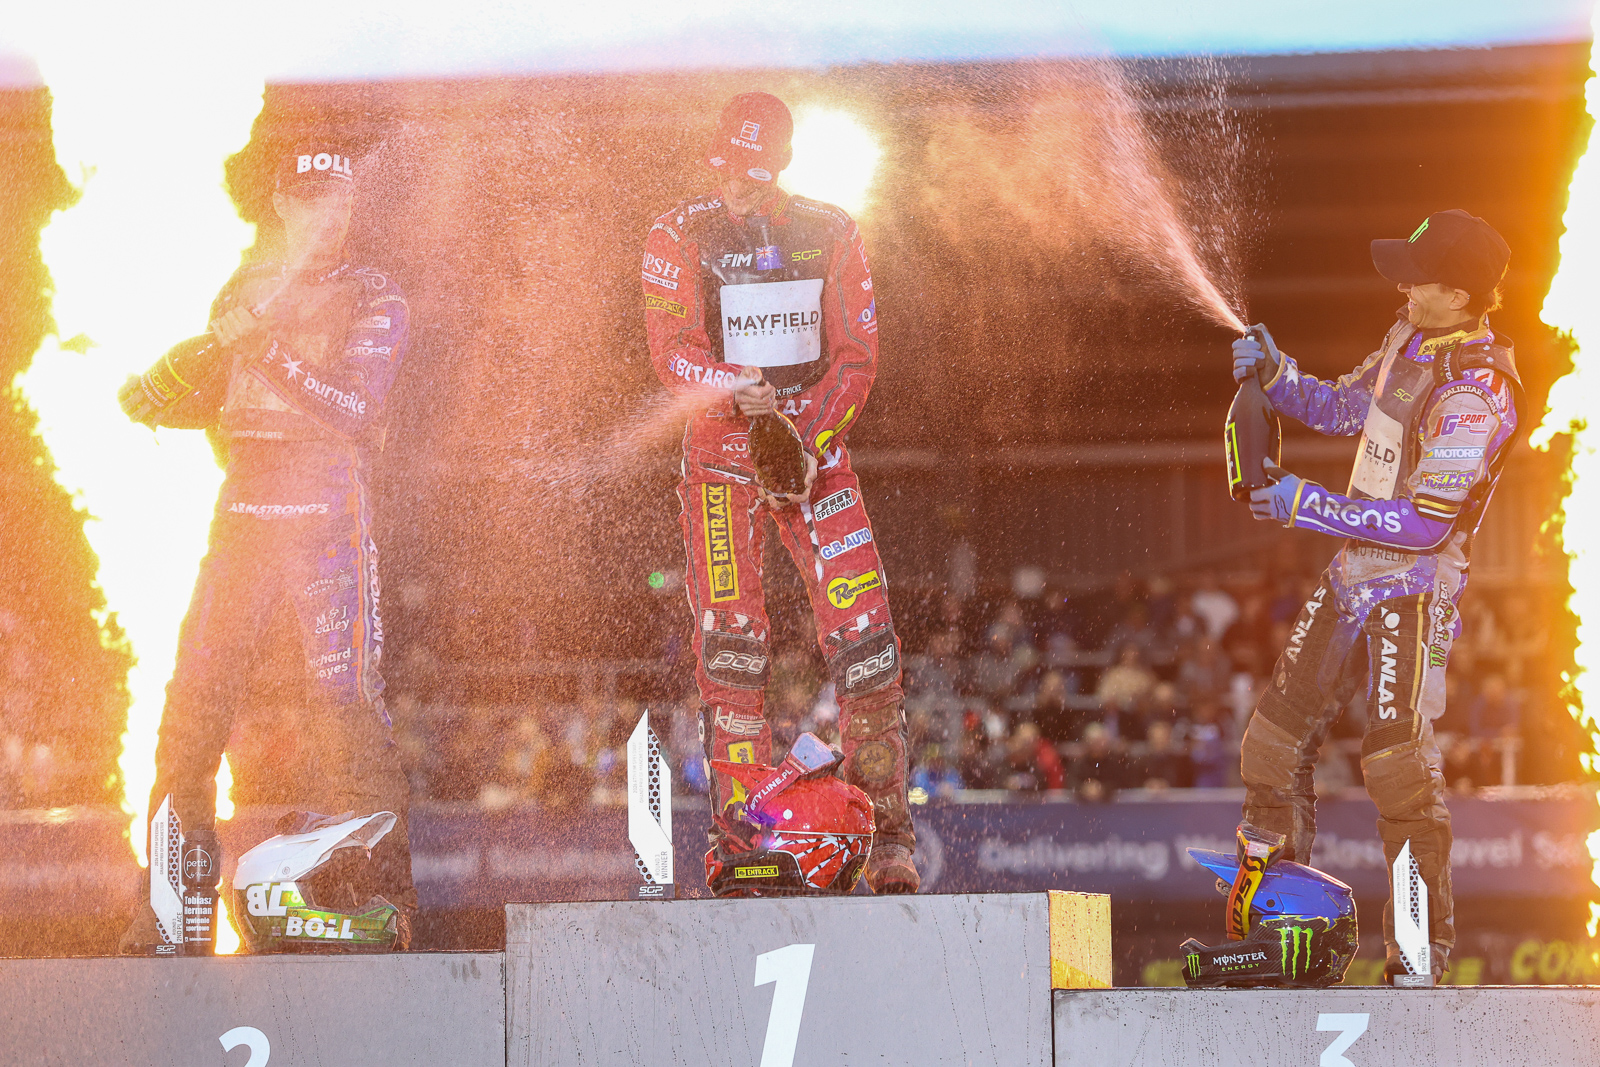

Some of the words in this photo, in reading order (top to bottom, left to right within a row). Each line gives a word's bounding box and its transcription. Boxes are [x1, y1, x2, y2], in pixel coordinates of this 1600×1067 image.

[731, 137, 762, 151] BETARD
[297, 153, 352, 175] BOLL
[688, 199, 722, 215] ANLAS
[719, 253, 753, 268] FIM
[791, 249, 822, 262] SGP
[728, 311, 819, 330] MAYFIELD
[781, 383, 802, 396] FRICKE
[1440, 385, 1483, 401] MALINIAK
[1458, 413, 1487, 424] SPORT
[256, 430, 283, 439] KURTZ
[1434, 448, 1485, 459] MOTOREX
[816, 499, 853, 520] SPEEDWAY
[1302, 491, 1402, 533] ARGOS
[708, 485, 729, 562] ENTRACK
[315, 614, 327, 628] M
[1285, 586, 1327, 664] ANLAS
[708, 651, 767, 675] pod
[846, 644, 895, 689] pod
[1378, 637, 1398, 720] ANLAS
[186, 859, 208, 871] petit
[660, 850, 668, 879] WINNER
[746, 867, 776, 876] ENTRACK
[639, 885, 664, 893] SGP
[184, 896, 212, 905] Tobiasz
[1228, 879, 1254, 937] SCOT
[286, 916, 354, 939] BOLL
[156, 945, 176, 953] SGP
[1213, 950, 1267, 965] MONSTER
[1221, 962, 1260, 971] ENERGY
[753, 943, 815, 1067] 1
